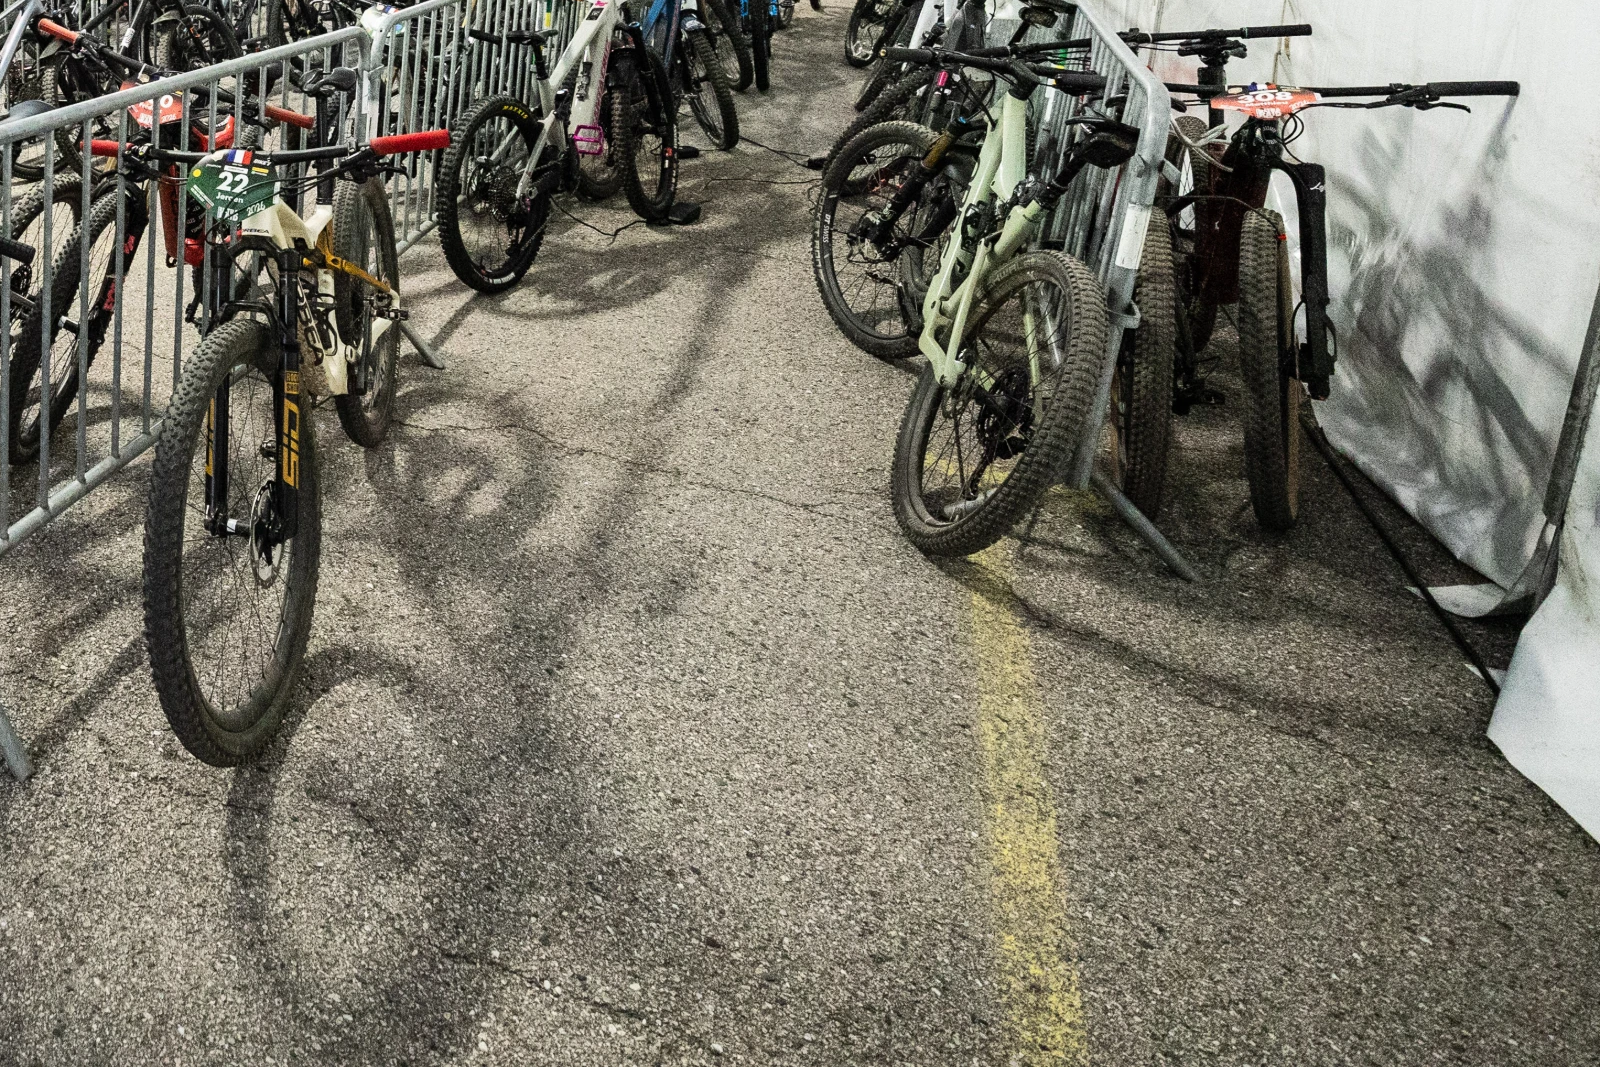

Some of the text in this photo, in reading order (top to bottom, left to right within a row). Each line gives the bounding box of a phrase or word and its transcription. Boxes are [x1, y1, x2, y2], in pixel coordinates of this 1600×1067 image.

[1237, 92, 1293, 104] 308
[502, 105, 529, 119] MAXXIS
[215, 171, 250, 195] 22
[822, 213, 832, 244] DT SWISS
